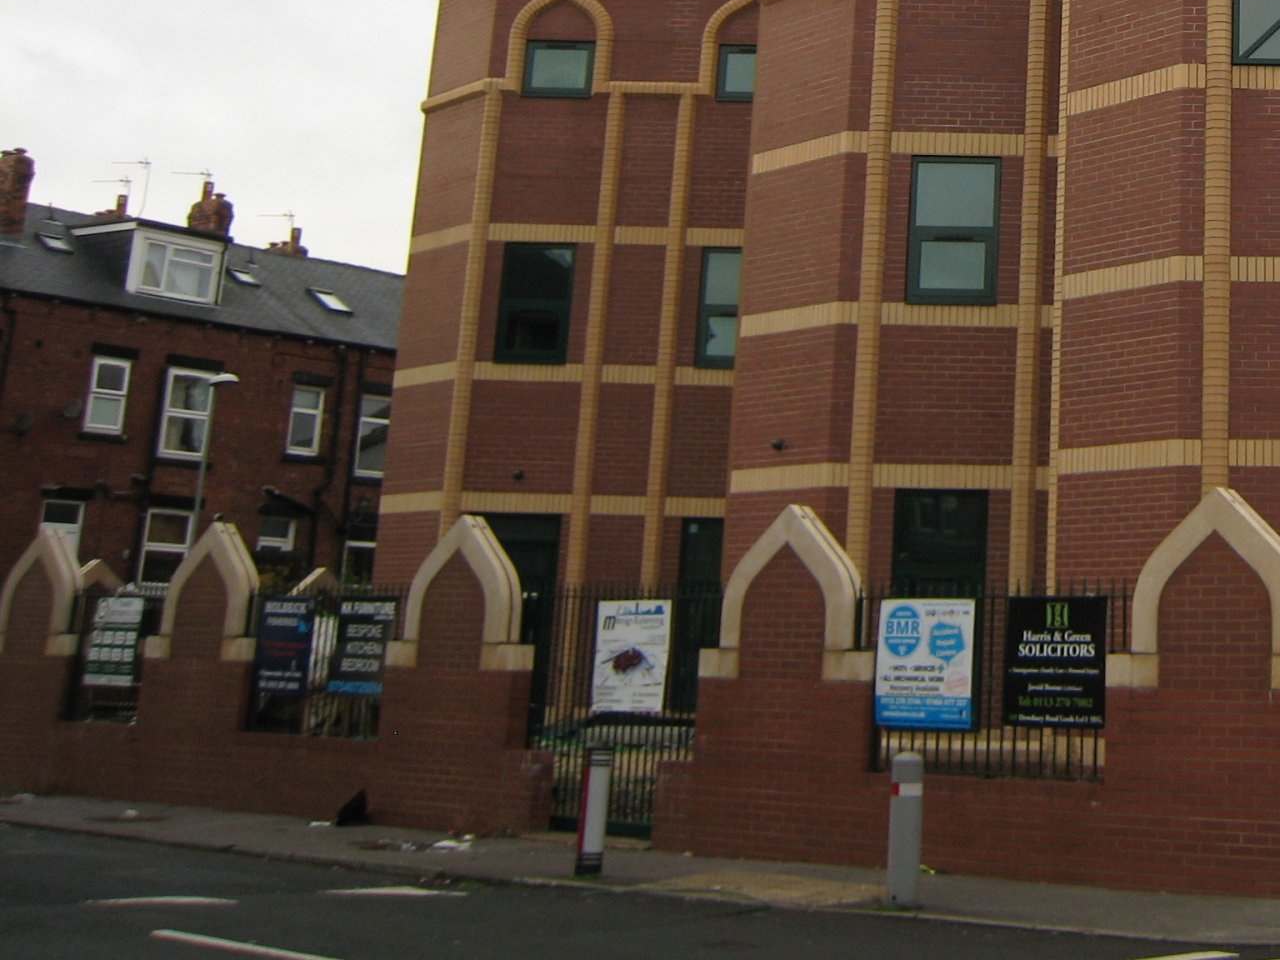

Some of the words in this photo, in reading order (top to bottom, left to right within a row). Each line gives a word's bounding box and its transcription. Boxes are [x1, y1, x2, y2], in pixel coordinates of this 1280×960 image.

[347, 624, 384, 637] BESPOKE
[886, 621, 920, 635] BMR
[1023, 630, 1051, 642] Harris
[1053, 630, 1062, 642] &
[1064, 630, 1091, 642] Green
[1018, 644, 1096, 657] SOLICITORS
[341, 658, 381, 672] BEDROOM
